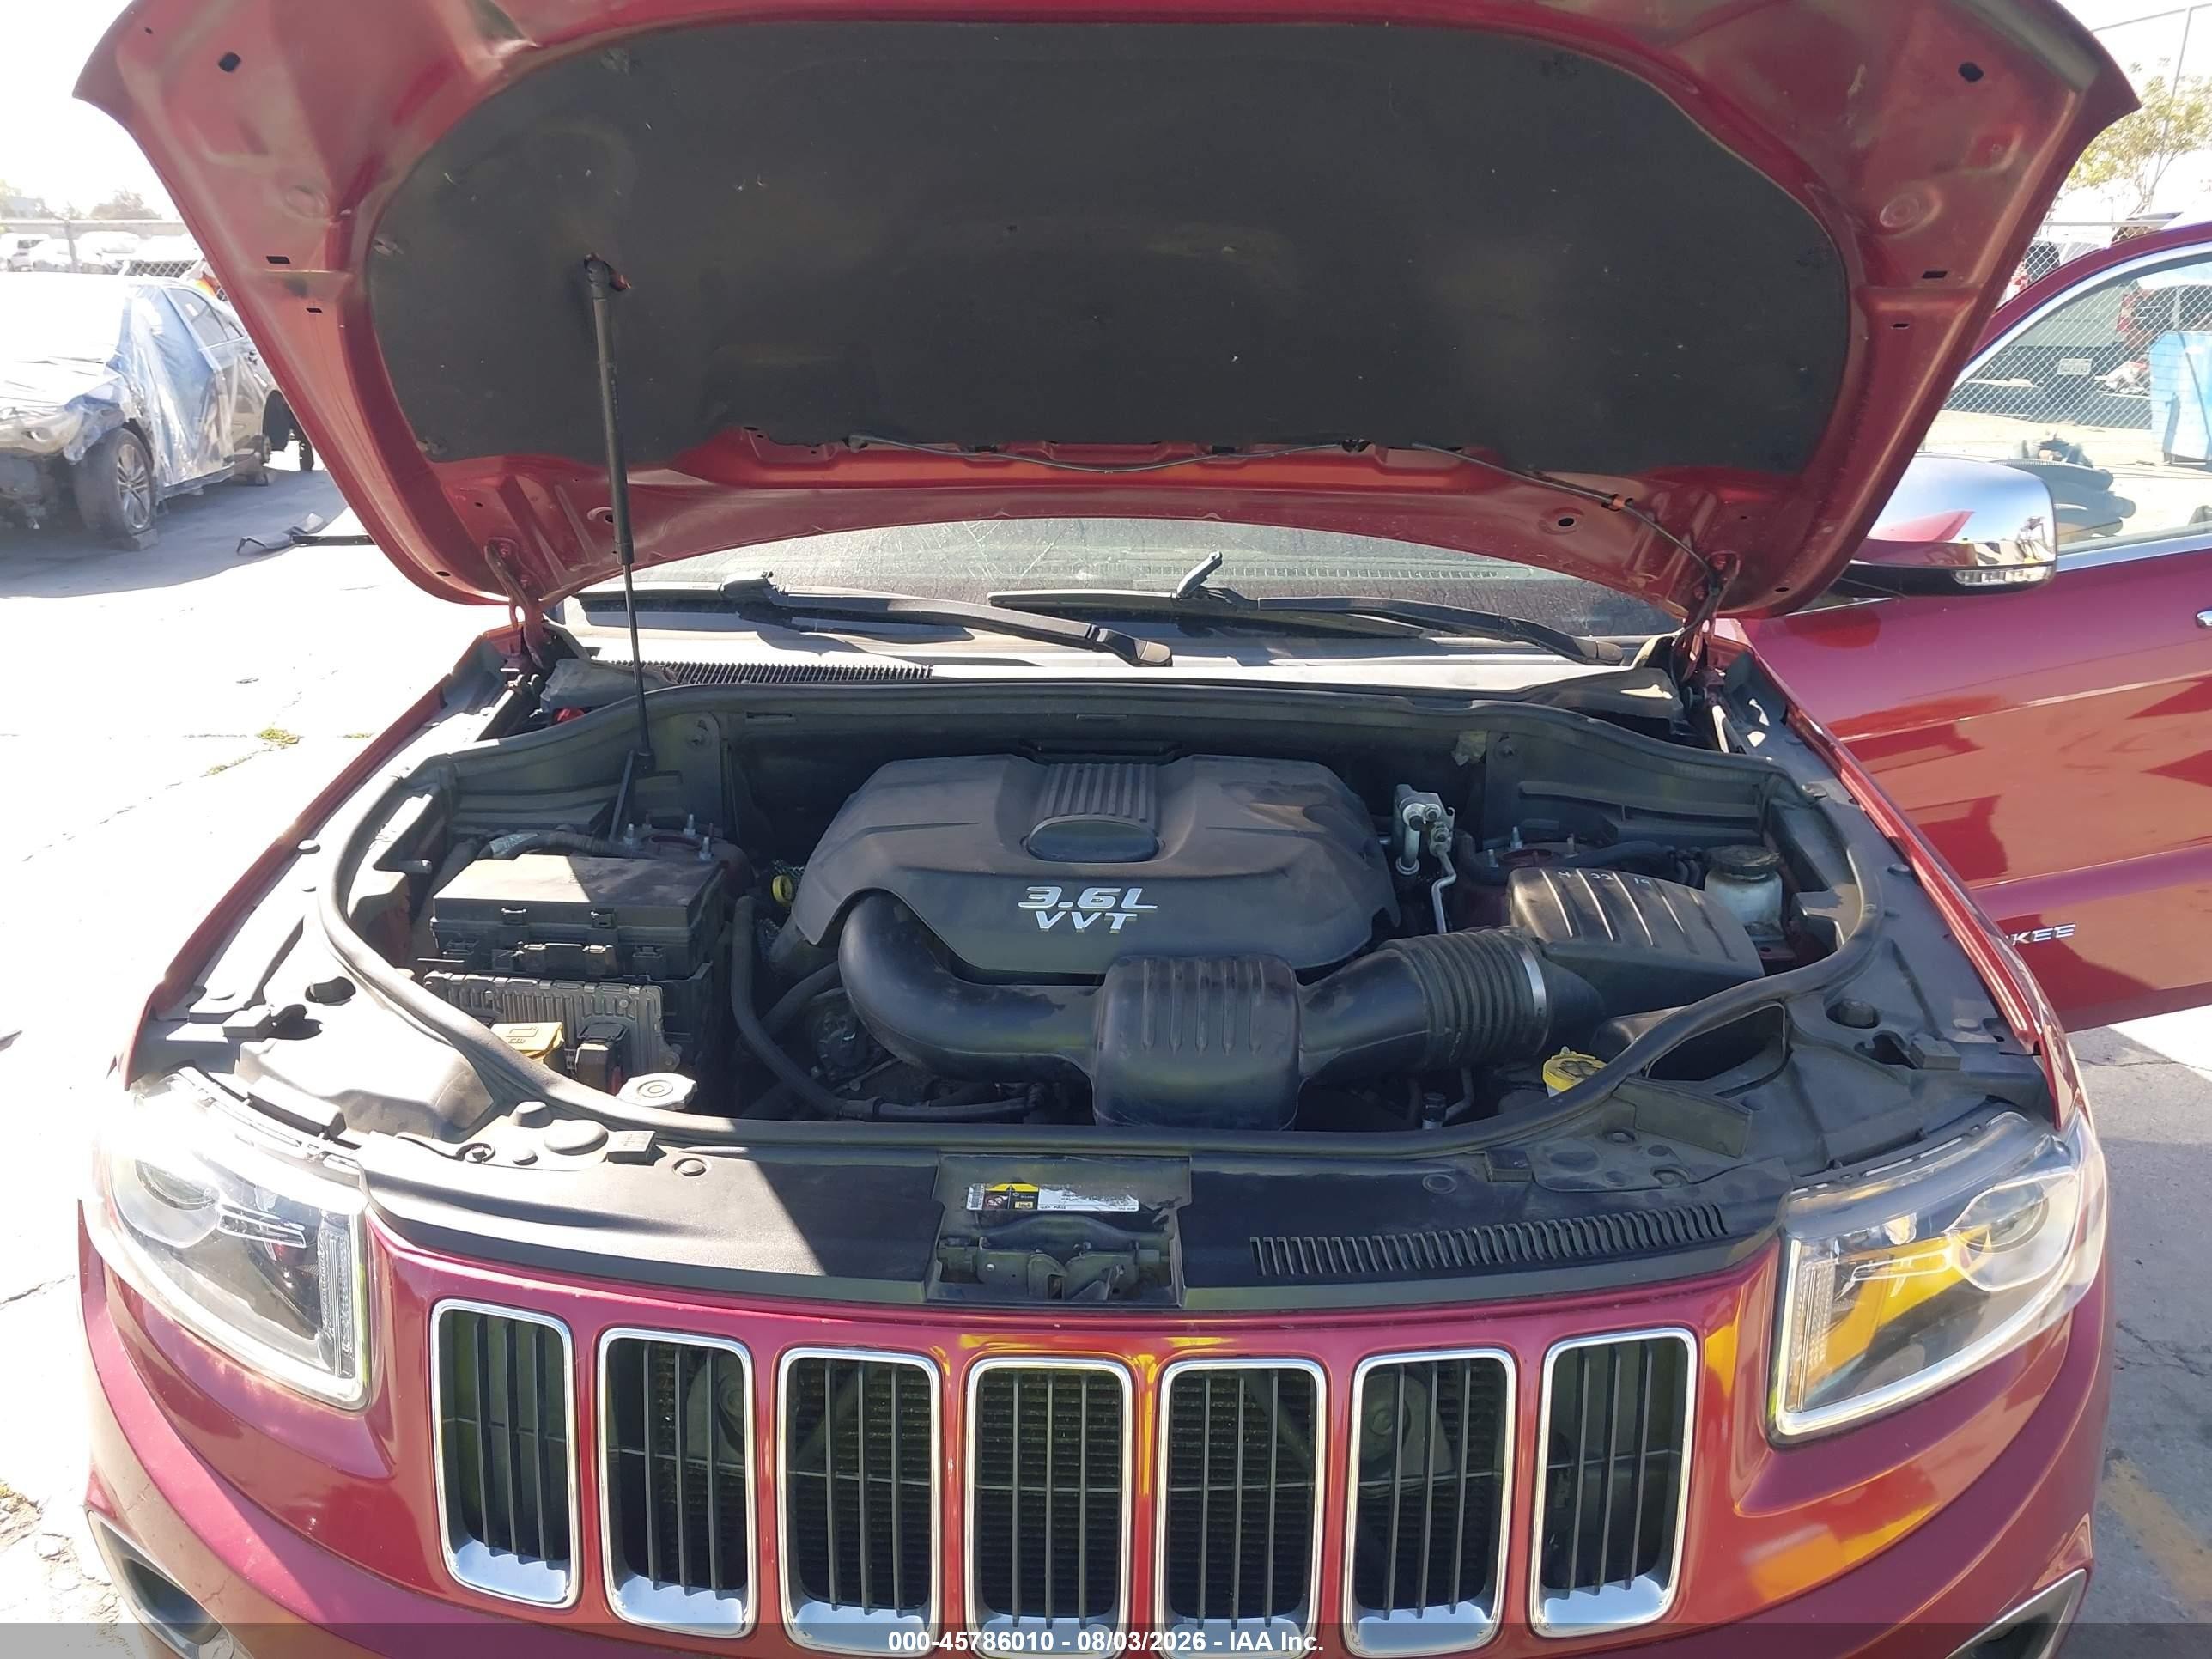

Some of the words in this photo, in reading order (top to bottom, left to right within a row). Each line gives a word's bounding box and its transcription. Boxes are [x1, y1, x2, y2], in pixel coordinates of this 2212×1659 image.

[1018, 885, 1158, 910] 3.6L
[1035, 910, 1139, 933] VVT
[2006, 922, 2077, 946] KEE
